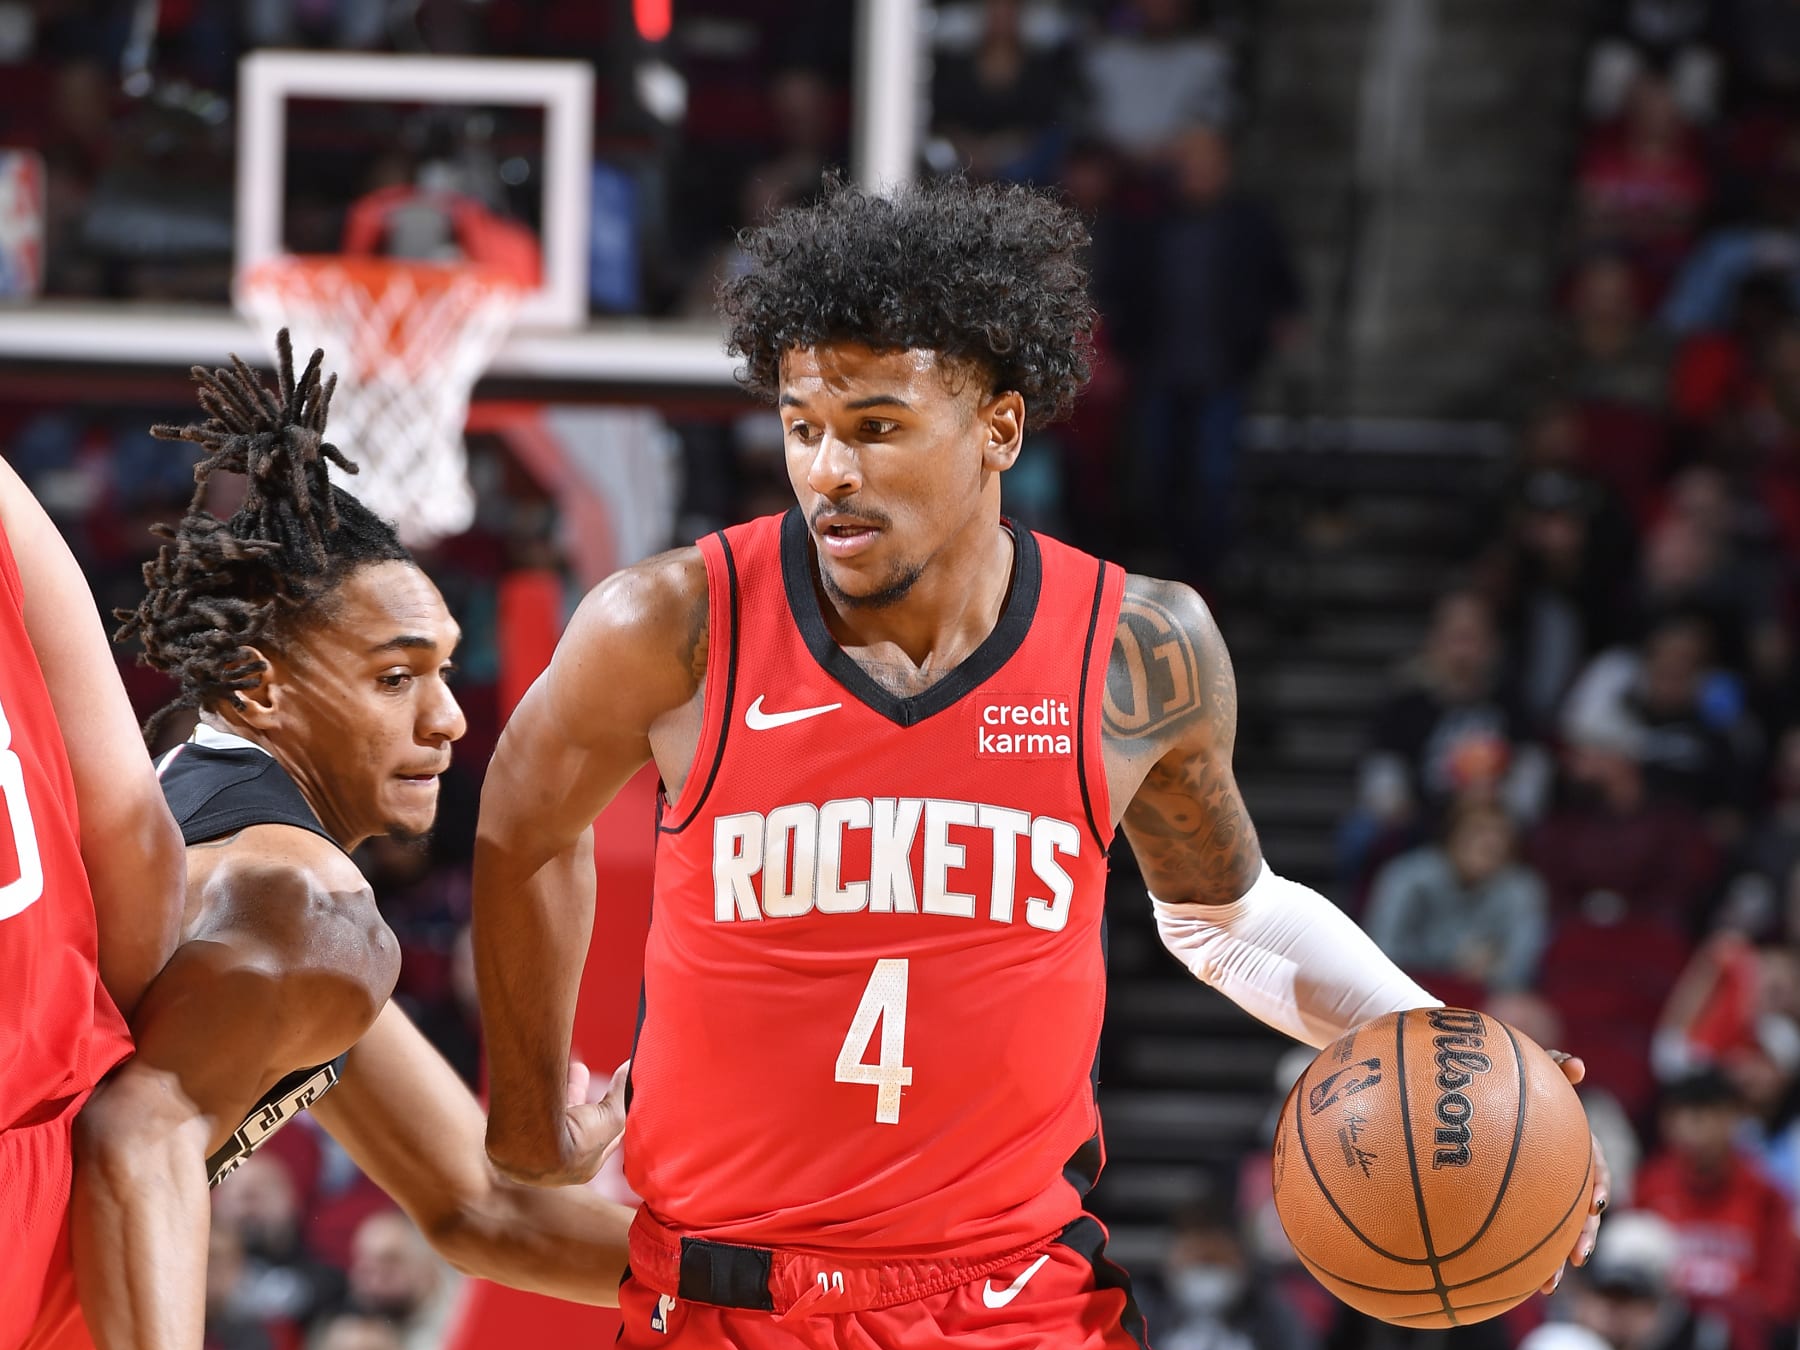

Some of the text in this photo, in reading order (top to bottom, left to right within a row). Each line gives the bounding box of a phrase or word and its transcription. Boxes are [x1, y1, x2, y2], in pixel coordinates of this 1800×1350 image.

[978, 726, 1071, 754] karma
[983, 698, 1070, 726] credit
[714, 797, 1080, 932] ROCKETS
[834, 959, 912, 1124] 4
[1426, 1009, 1492, 1170] Wilson
